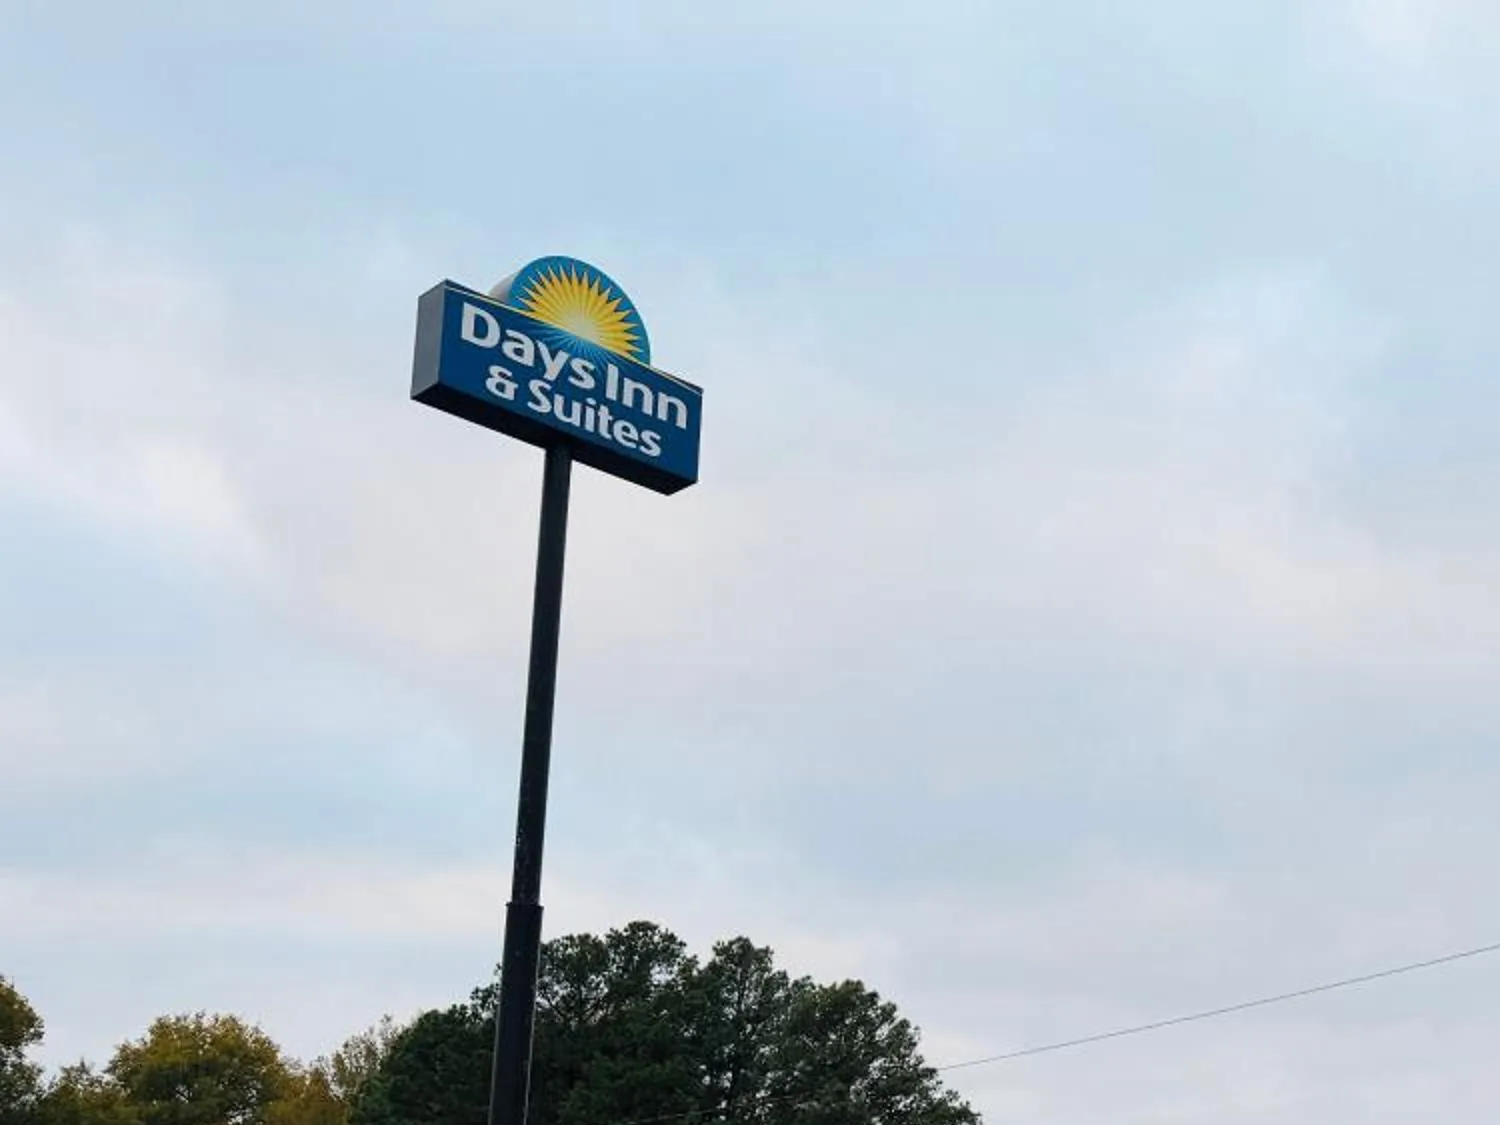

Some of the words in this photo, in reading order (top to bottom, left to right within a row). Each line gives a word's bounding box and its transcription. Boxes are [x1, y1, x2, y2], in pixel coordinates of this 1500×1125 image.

[460, 301, 597, 391] Days
[605, 362, 688, 430] Inn
[485, 364, 519, 401] &
[527, 379, 662, 457] Suites
